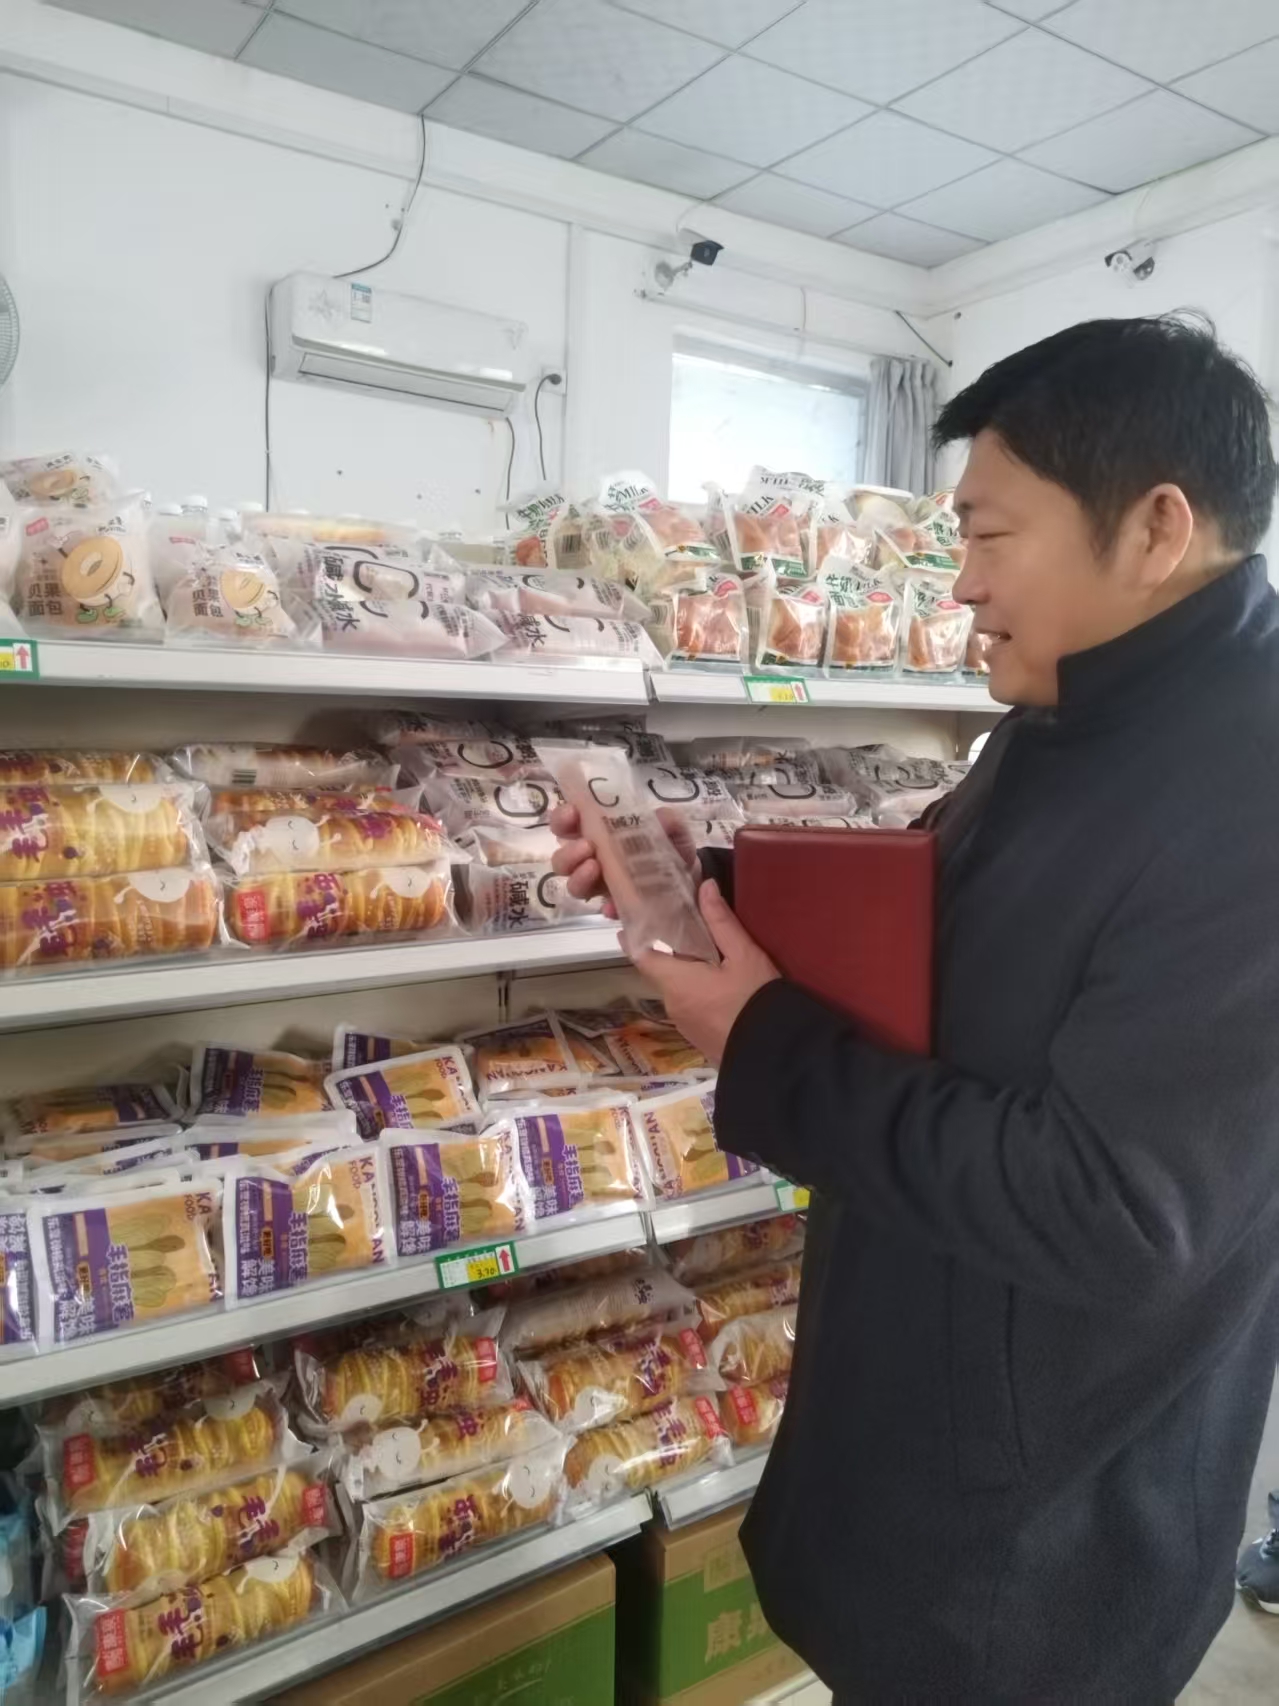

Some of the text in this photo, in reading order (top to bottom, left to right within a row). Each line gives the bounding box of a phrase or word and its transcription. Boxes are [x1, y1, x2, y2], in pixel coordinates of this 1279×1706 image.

[28, 599, 64, 618] 面包
[509, 880, 530, 929] 碱水
[107, 1243, 134, 1324] 手指麻薯
[475, 1266, 497, 1279] 3.70
